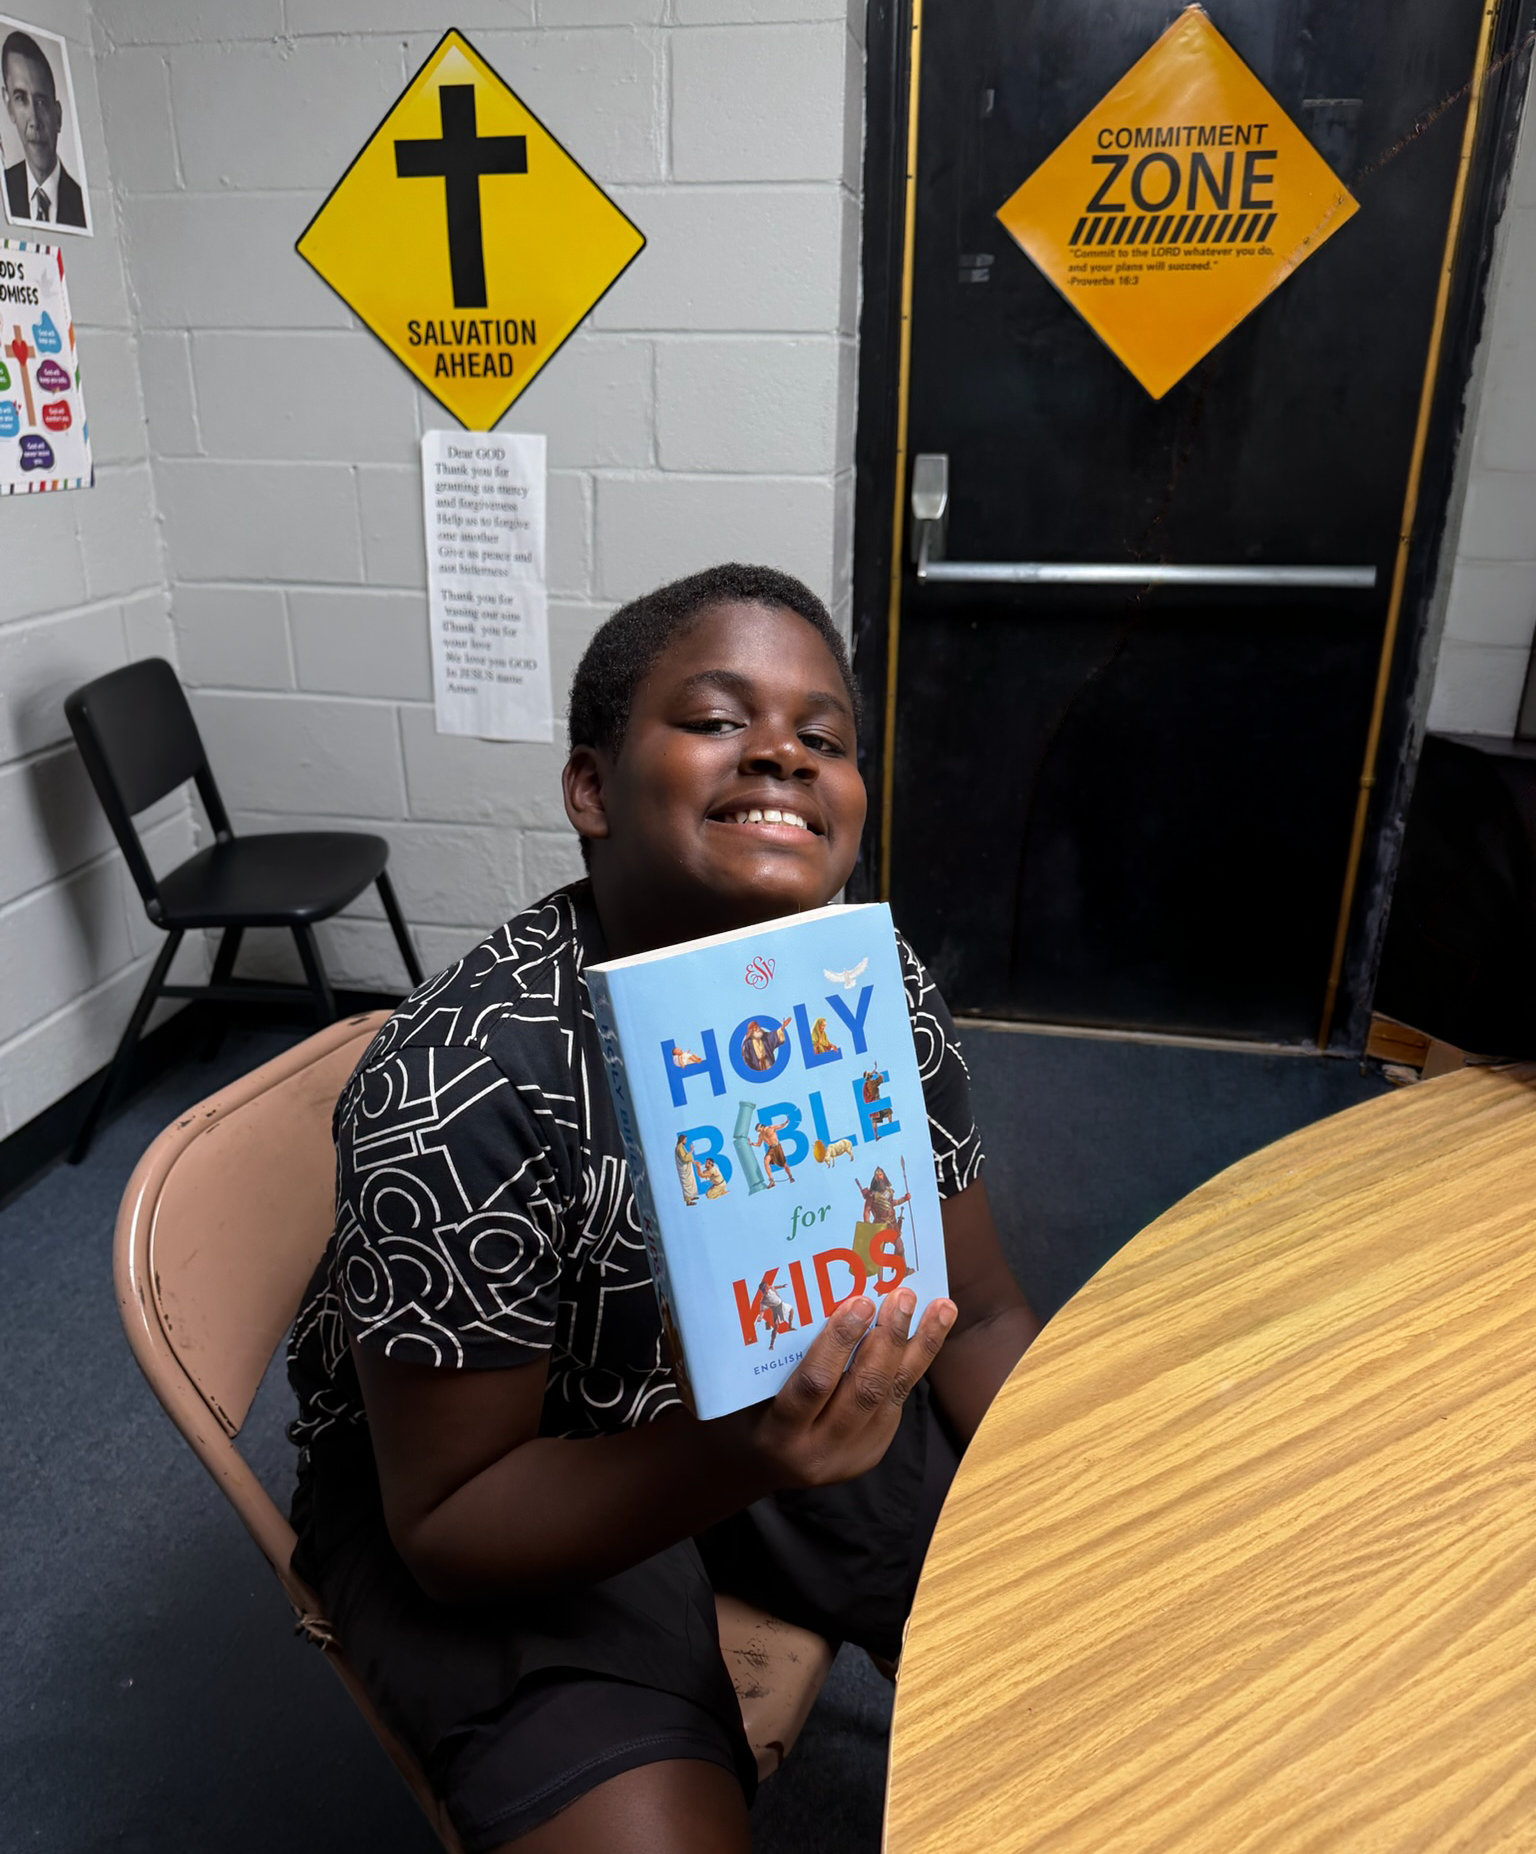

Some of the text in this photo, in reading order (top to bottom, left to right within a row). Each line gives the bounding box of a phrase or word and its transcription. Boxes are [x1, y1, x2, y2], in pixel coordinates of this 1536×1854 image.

[1097, 124, 1269, 149] COMMITMENT
[1085, 150, 1278, 214] ZONE
[1118, 249, 1129, 257] to
[1131, 247, 1149, 257] the
[1151, 247, 1180, 257] LORD
[1183, 246, 1232, 257] whatever
[1235, 247, 1255, 258] you
[1258, 245, 1275, 256] do,
[0, 260, 25, 281] OD'S
[1068, 262, 1087, 272] and
[1090, 264, 1112, 274] your
[1115, 261, 1143, 274] plans
[1146, 260, 1165, 271] will
[1118, 275, 1139, 286] 16:3
[0, 284, 39, 306] OMISES
[408, 319, 537, 346] SALVATION
[434, 352, 513, 378] AHEAD
[448, 447, 506, 461] Dear GOD
[435, 462, 510, 479] Thank you for
[482, 485, 496, 494] us
[497, 486, 530, 499] mercy
[436, 496, 518, 512] and forgiveness
[436, 513, 530, 531] Help us to forgive
[437, 531, 499, 543] one another
[438, 545, 533, 563] Give us peace and
[441, 589, 514, 606] Thank you for
[481, 626, 501, 638] you
[503, 626, 518, 638] for
[443, 638, 492, 651] your love
[464, 654, 486, 667] love
[488, 657, 507, 669] you
[508, 657, 538, 671] GOD
[459, 668, 495, 683] JESUS
[745, 956, 776, 990] ESV
[660, 985, 874, 1107] HOLY
[675, 1070, 901, 1200] BIBLE
[787, 1206, 831, 1241] for
[732, 1229, 906, 1347] KIDS
[753, 1351, 803, 1376] ENGLISH
